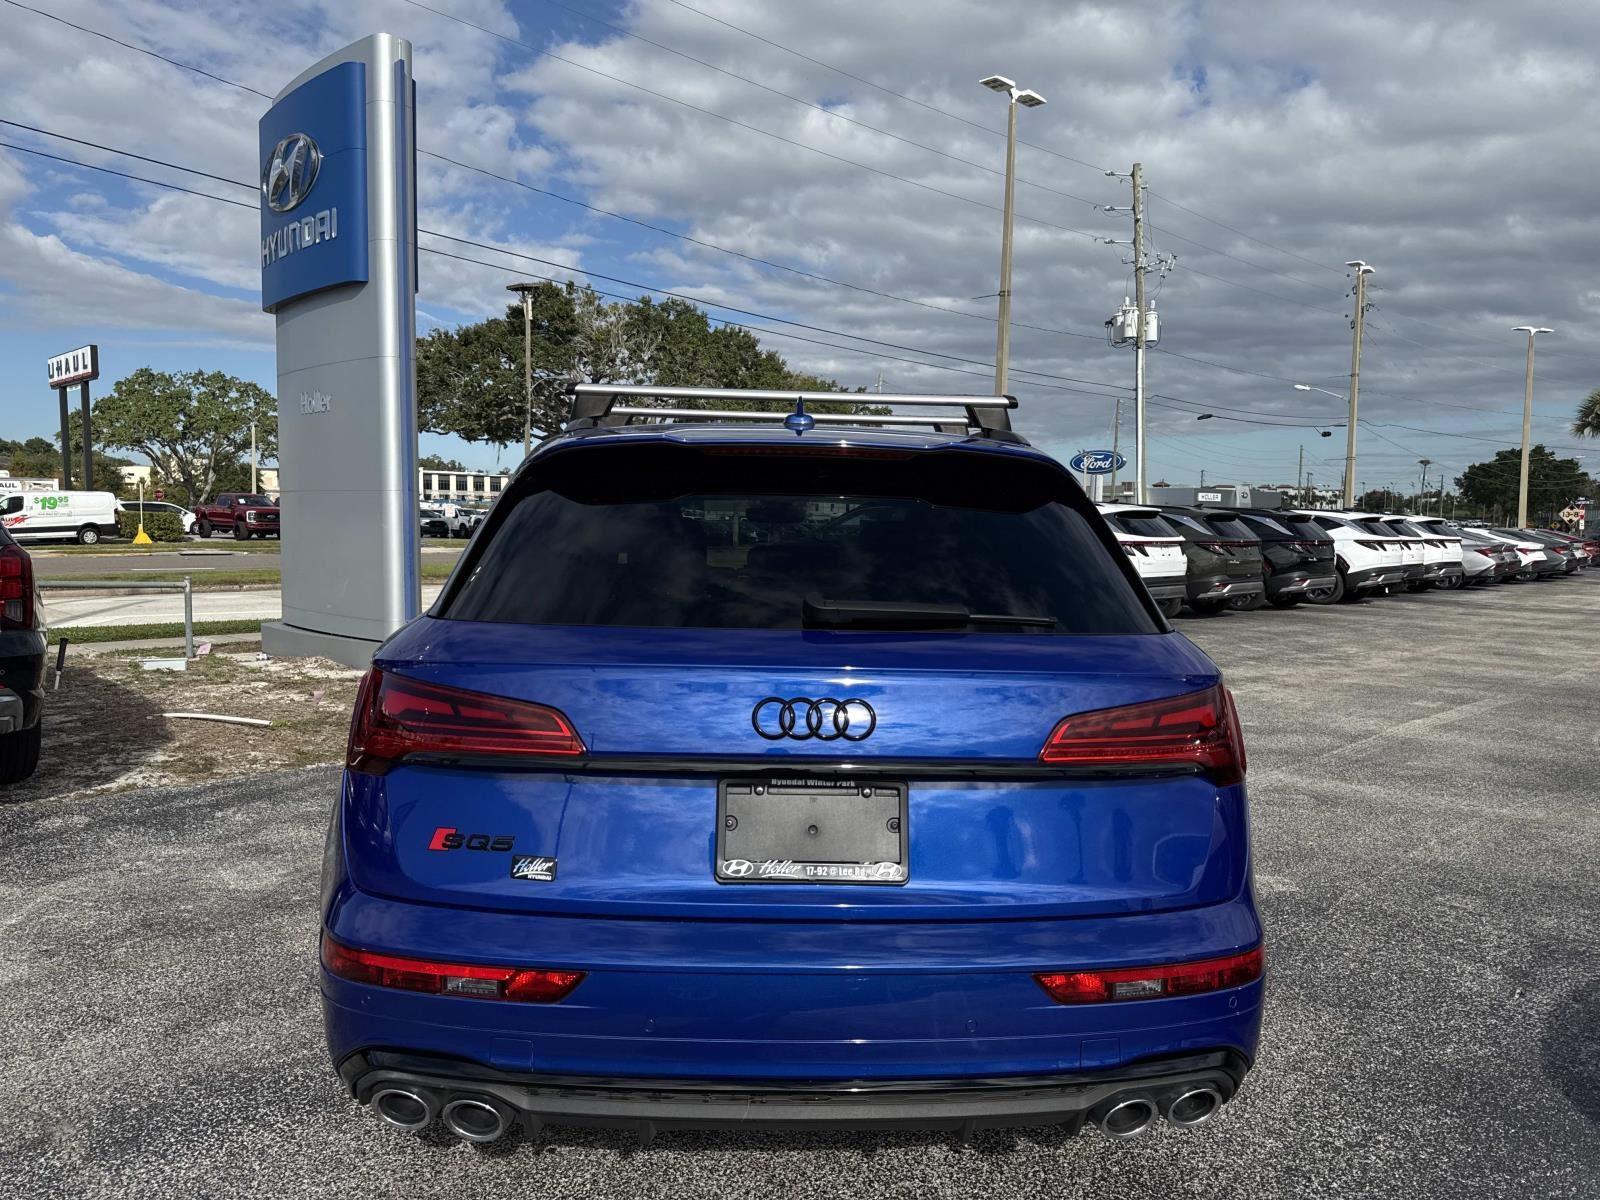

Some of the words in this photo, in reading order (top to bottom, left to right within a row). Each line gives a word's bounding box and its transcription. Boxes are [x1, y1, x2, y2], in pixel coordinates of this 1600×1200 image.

[262, 207, 337, 267] HYUNDAI
[300, 389, 332, 413] Holler
[1080, 454, 1113, 469] Ford
[771, 778, 805, 786] Hyundai
[806, 779, 835, 787] Winter
[836, 780, 856, 788] Park
[440, 833, 515, 851] SQ5
[512, 858, 553, 873] Holler
[758, 859, 802, 877] Holler
[806, 866, 828, 876] 17-92
[838, 867, 854, 877] Lee
